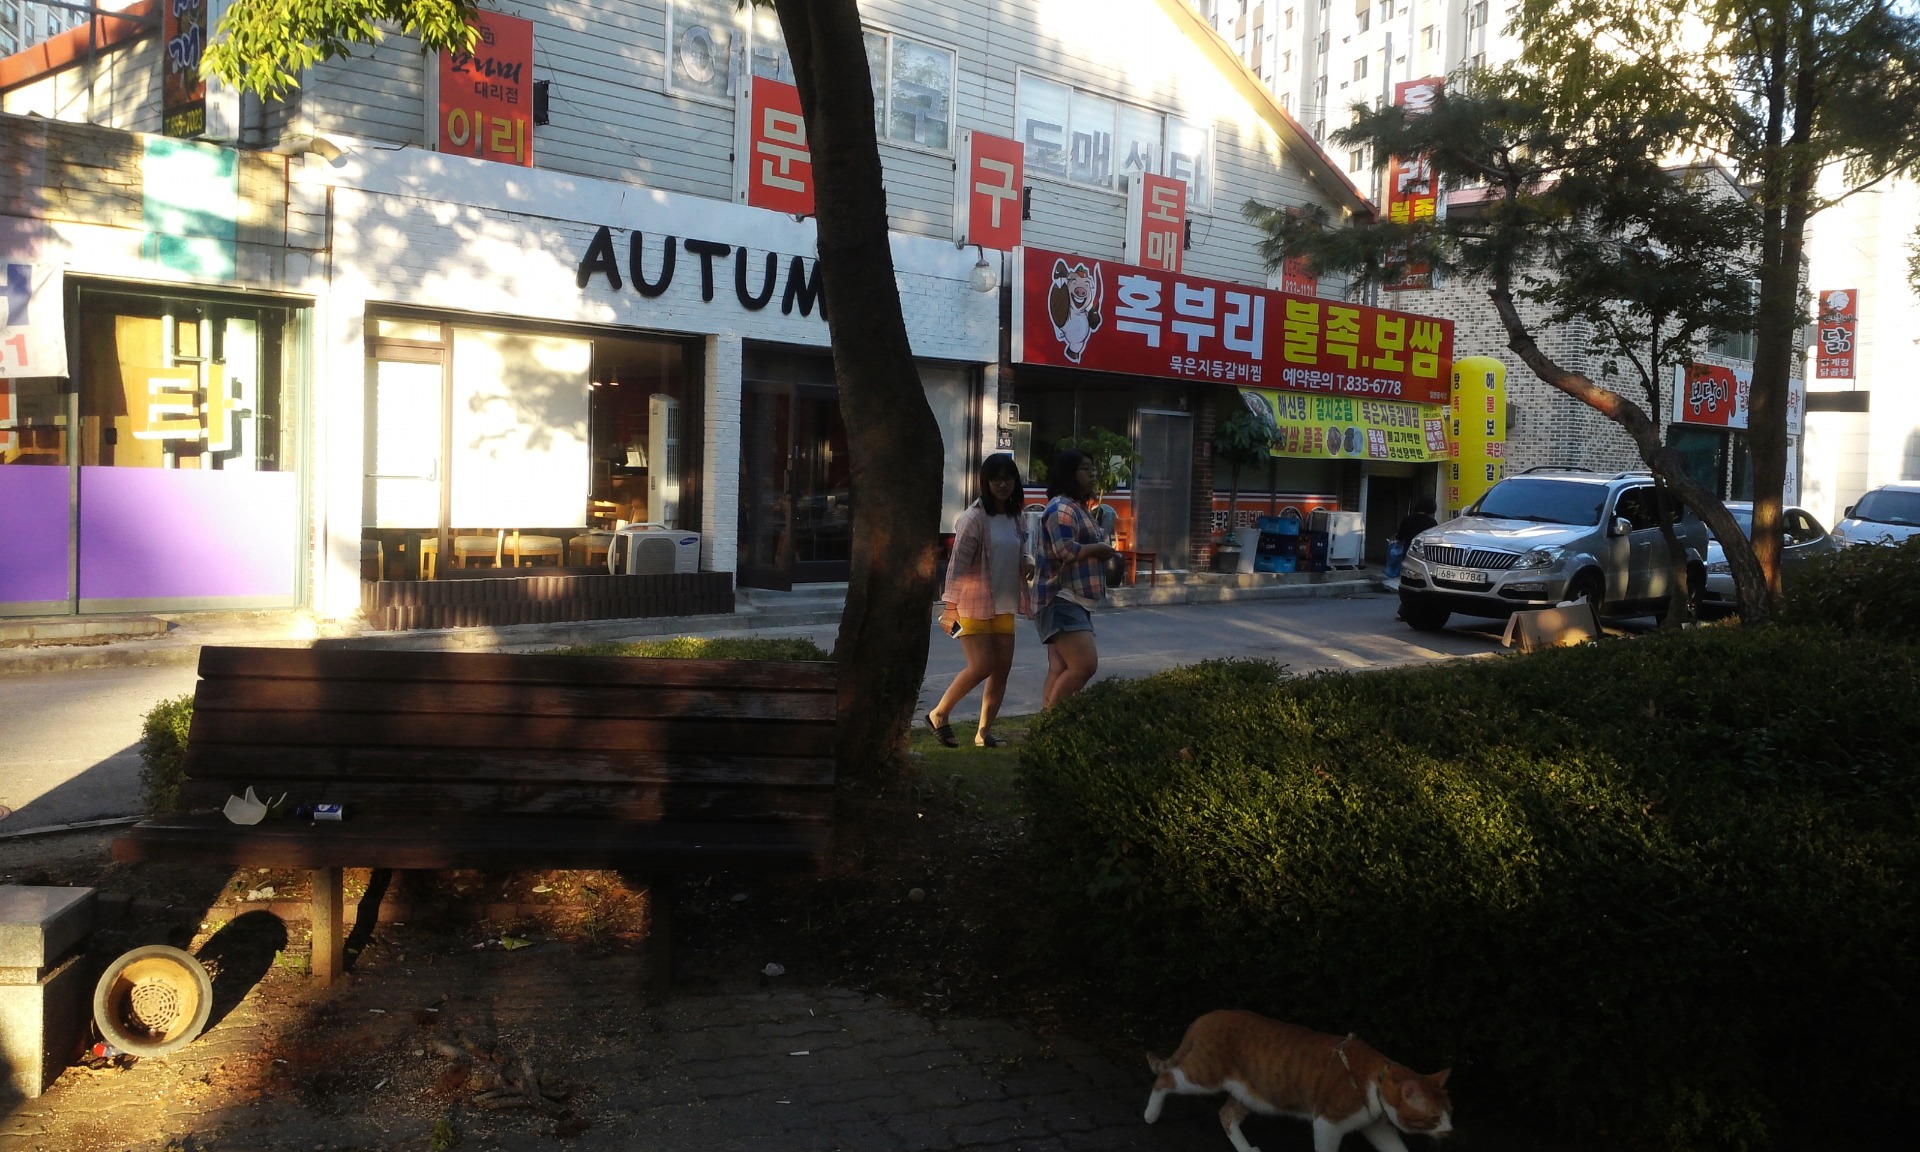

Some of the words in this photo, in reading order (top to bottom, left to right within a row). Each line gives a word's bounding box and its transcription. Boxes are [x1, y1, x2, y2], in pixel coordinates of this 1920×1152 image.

[474, 81, 519, 105] 대리점
[447, 107, 525, 163] 이리
[757, 107, 811, 193] 문
[975, 157, 1018, 229] 구
[1147, 185, 1180, 272] 도매
[1115, 274, 1265, 360] 혹부리
[1283, 298, 1443, 379] 불족.보쌈
[1821, 327, 1852, 355] 닭
[1170, 355, 1262, 382] 묵은지등갈비찜
[1282, 367, 1334, 391] 예약문의
[1336, 374, 1402, 396] T.835-6778
[1278, 394, 1306, 420] 해신탕
[1315, 397, 1353, 421] 갈치조림
[1368, 429, 1384, 443] 점심
[1371, 443, 1388, 458] 특선
[1459, 571, 1481, 582] 0784
